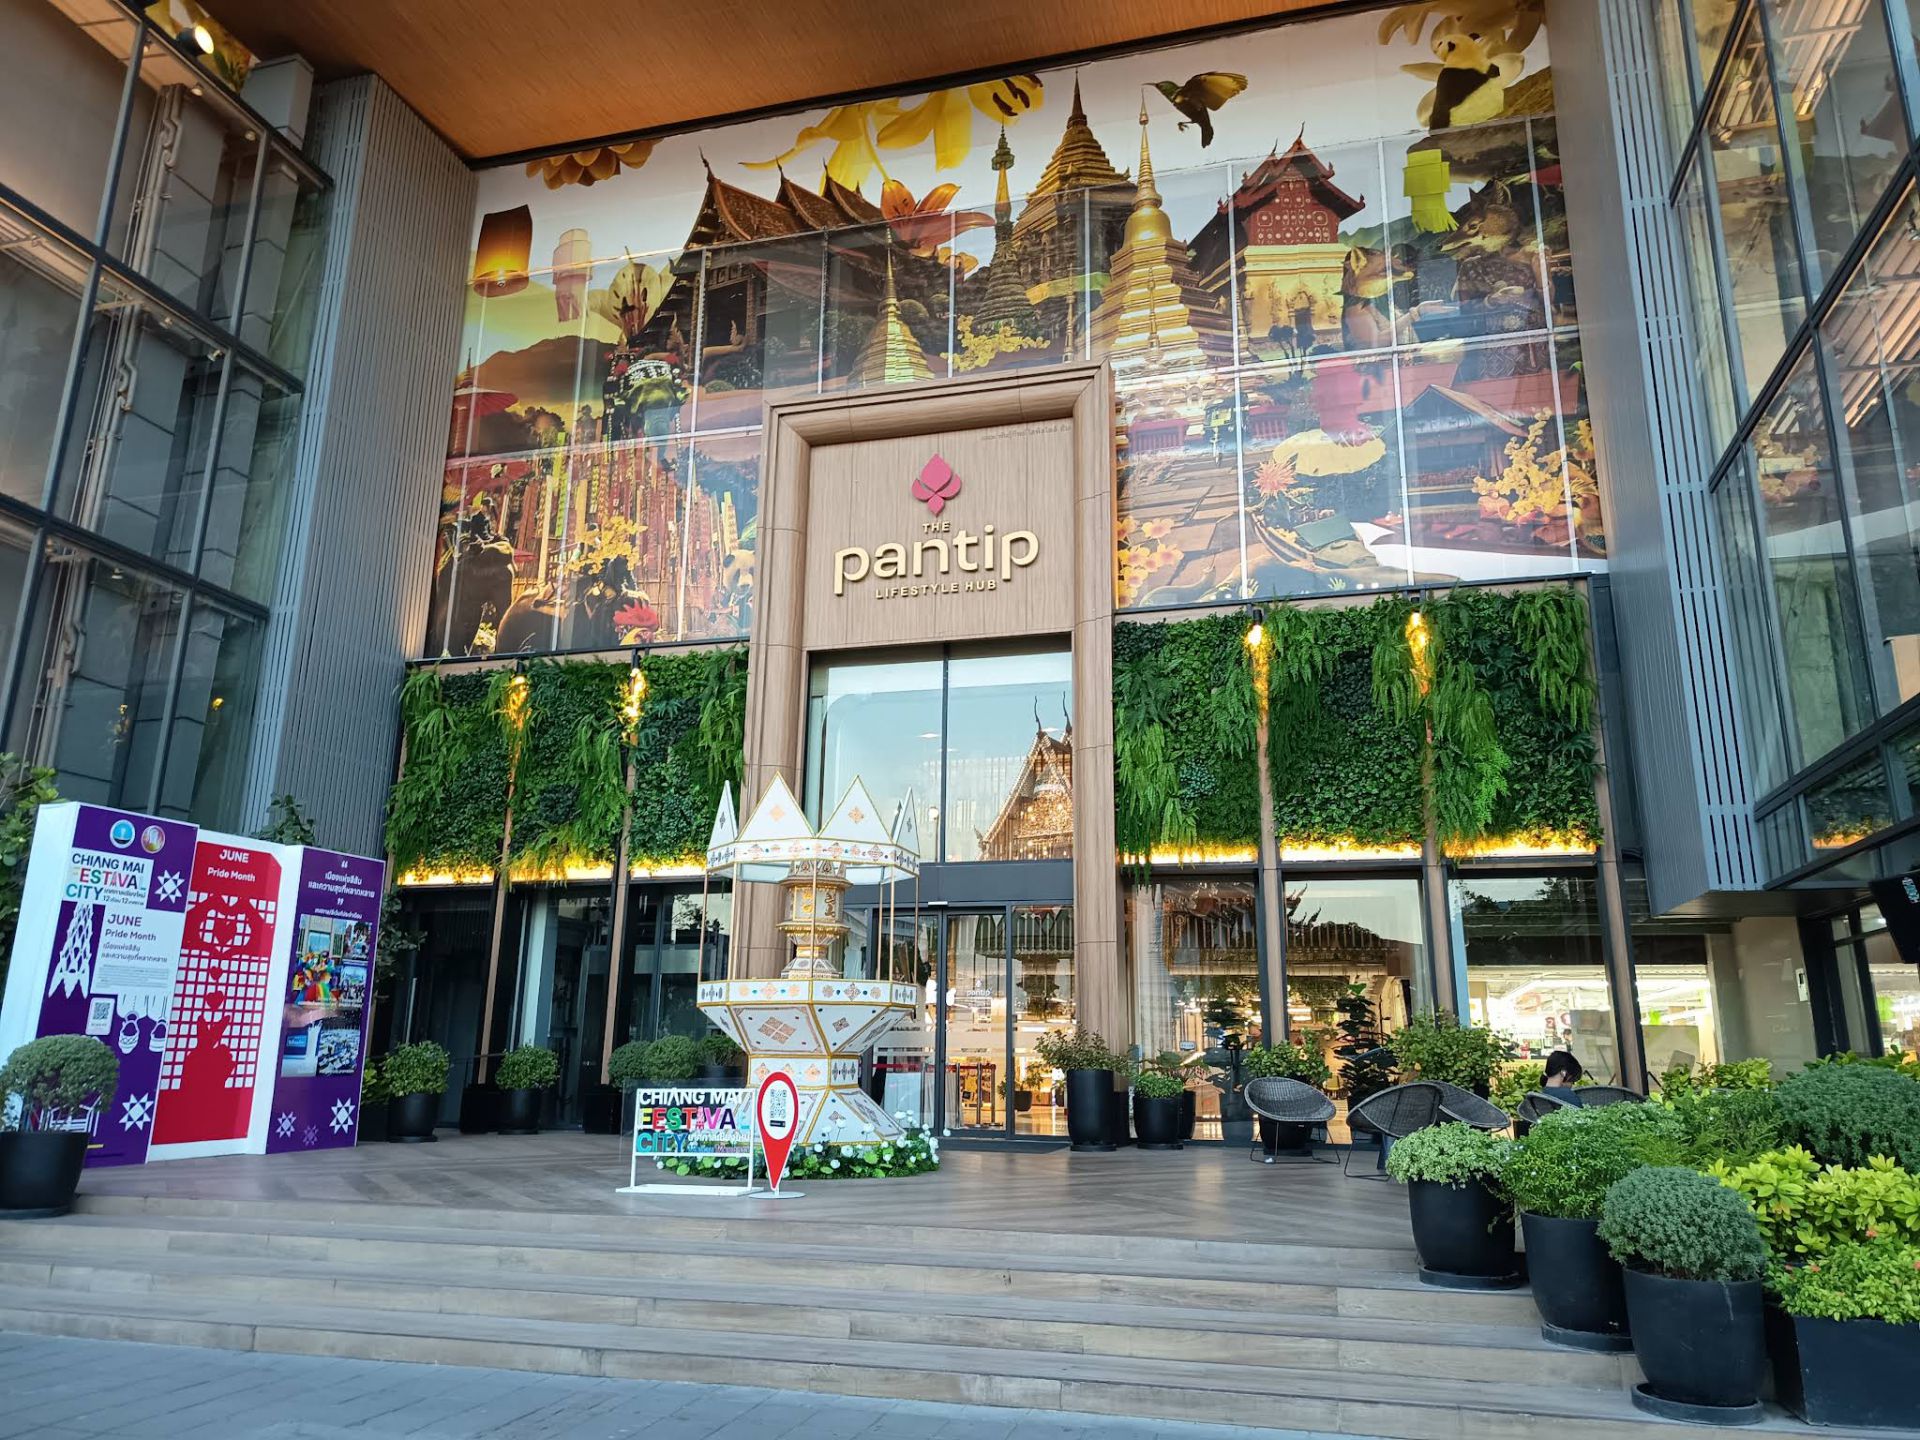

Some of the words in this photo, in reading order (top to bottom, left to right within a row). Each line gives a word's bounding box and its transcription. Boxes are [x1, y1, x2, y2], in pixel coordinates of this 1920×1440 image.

[922, 521, 951, 533] THE
[834, 524, 1040, 597] pantip
[876, 583, 959, 600] LIFESTYLE
[965, 579, 997, 592] HUB
[72, 853, 119, 870] CHIANG
[122, 861, 145, 874] MAI
[219, 849, 249, 863] JUNE
[73, 867, 146, 890] ESTIVA
[207, 866, 230, 879] Pride
[230, 870, 256, 882] Month
[65, 883, 103, 901] CITY
[107, 914, 142, 927] JUNE
[105, 928, 129, 938] Pride
[129, 931, 157, 941] Month
[640, 1090, 705, 1105] CHIANG
[709, 1090, 743, 1105] MAI
[637, 1132, 687, 1153] CITY
